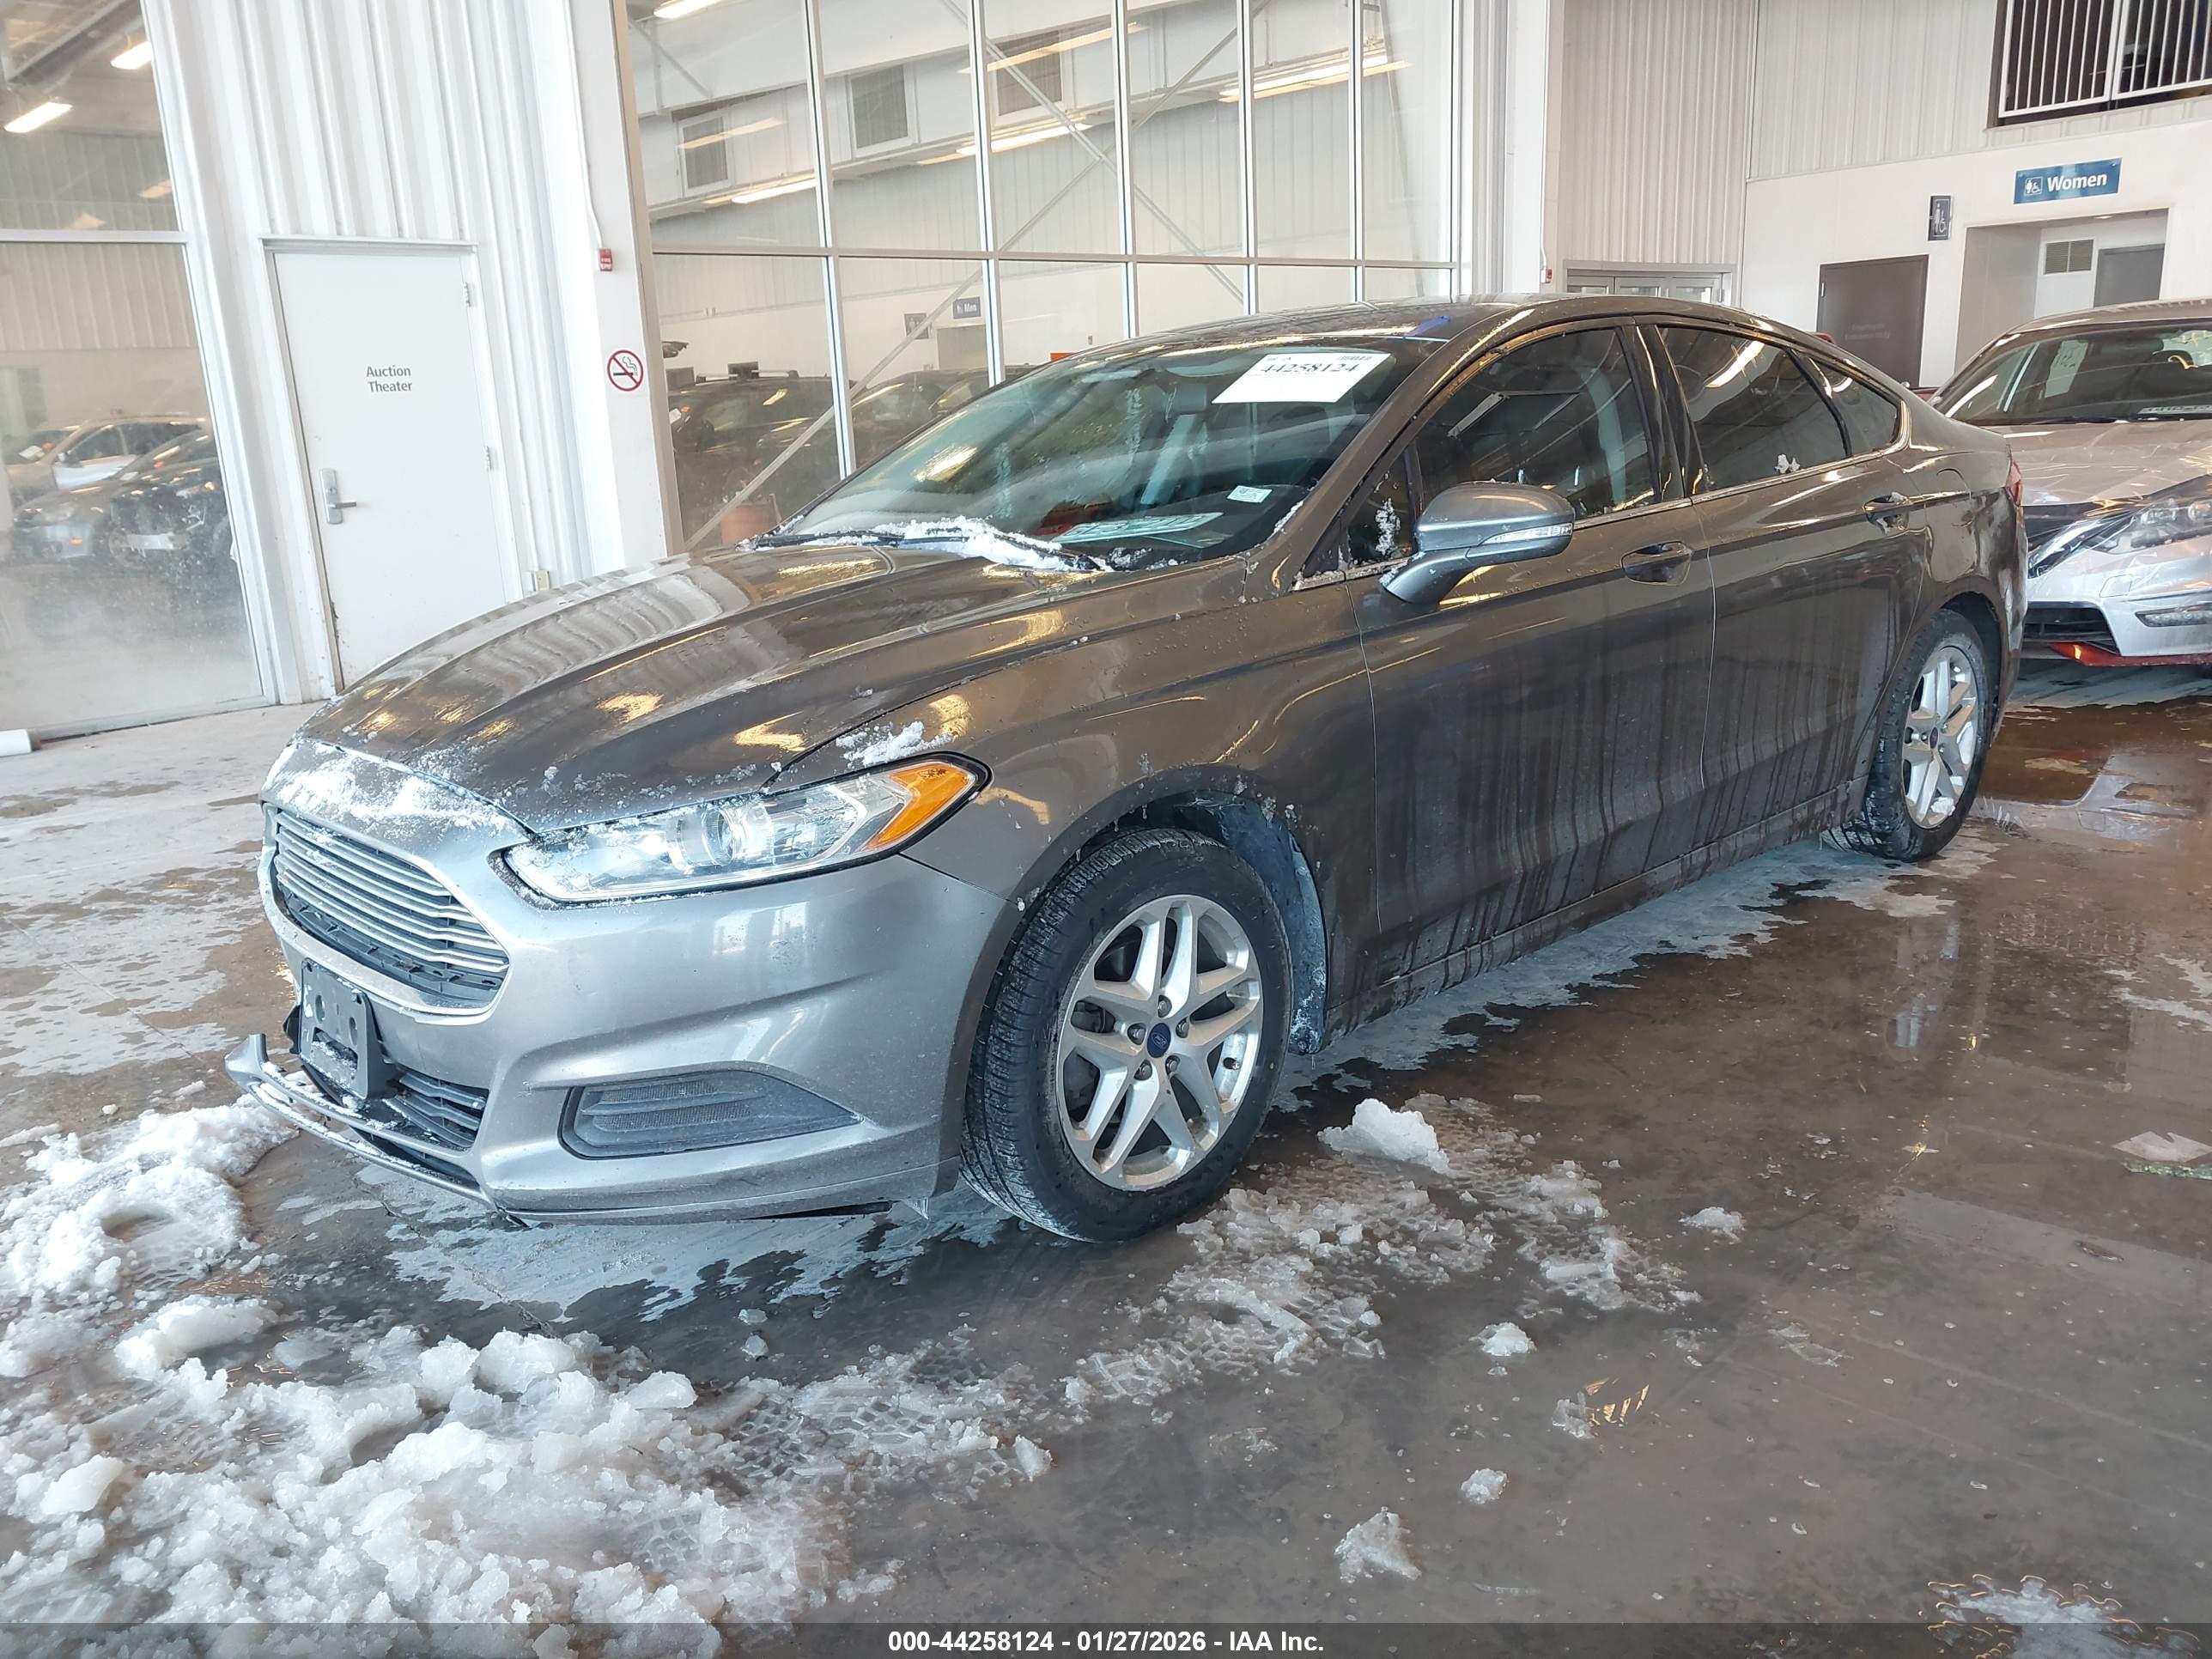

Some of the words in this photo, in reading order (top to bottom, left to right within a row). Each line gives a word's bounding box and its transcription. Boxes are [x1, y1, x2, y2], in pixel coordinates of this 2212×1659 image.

[2046, 173, 2107, 192] Women
[366, 365, 411, 378] Auction
[1261, 363, 1360, 374] 44258124
[368, 380, 413, 392] Theater
